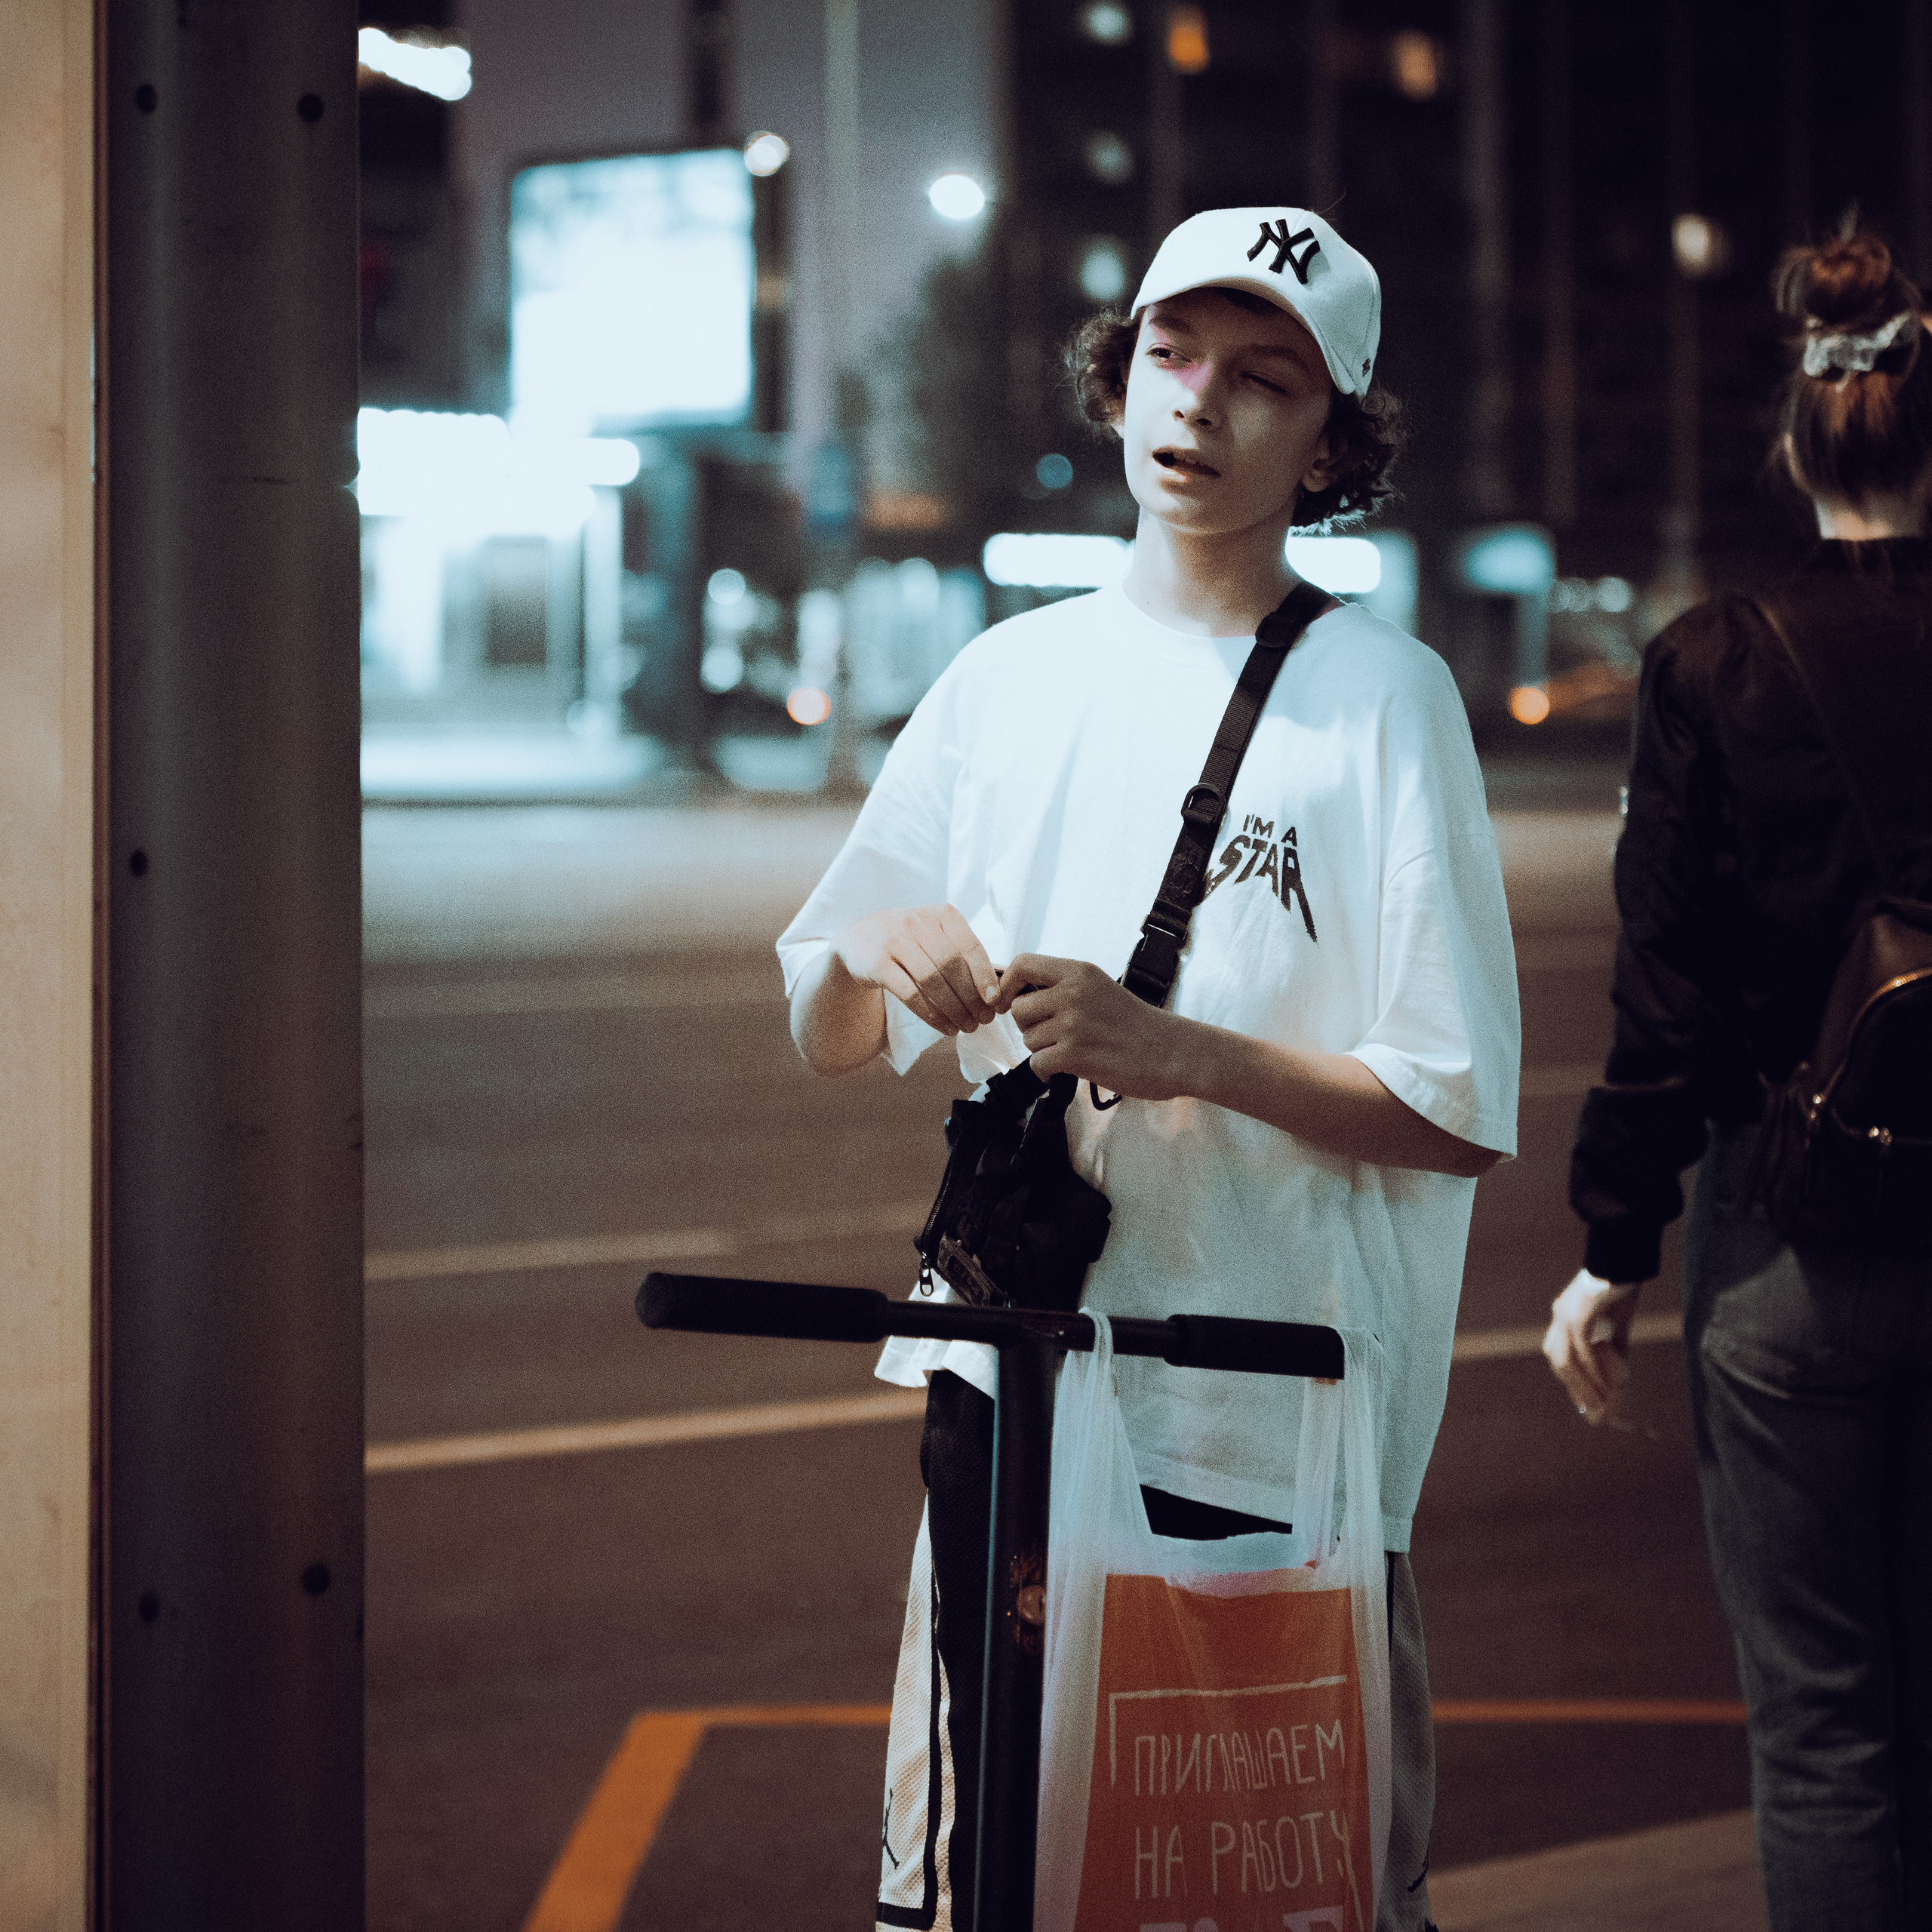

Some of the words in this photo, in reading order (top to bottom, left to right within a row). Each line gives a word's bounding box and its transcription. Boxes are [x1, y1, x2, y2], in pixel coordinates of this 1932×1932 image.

[1247, 218, 1321, 285] NY
[1243, 814, 1275, 838] I'M
[1281, 826, 1297, 847] A
[1203, 834, 1318, 945] STAR
[1134, 1719, 1346, 1796] ПРИГЛАШАЕМ
[1135, 1824, 1187, 1900] НА
[1211, 1810, 1354, 1895] РАБОТУ
